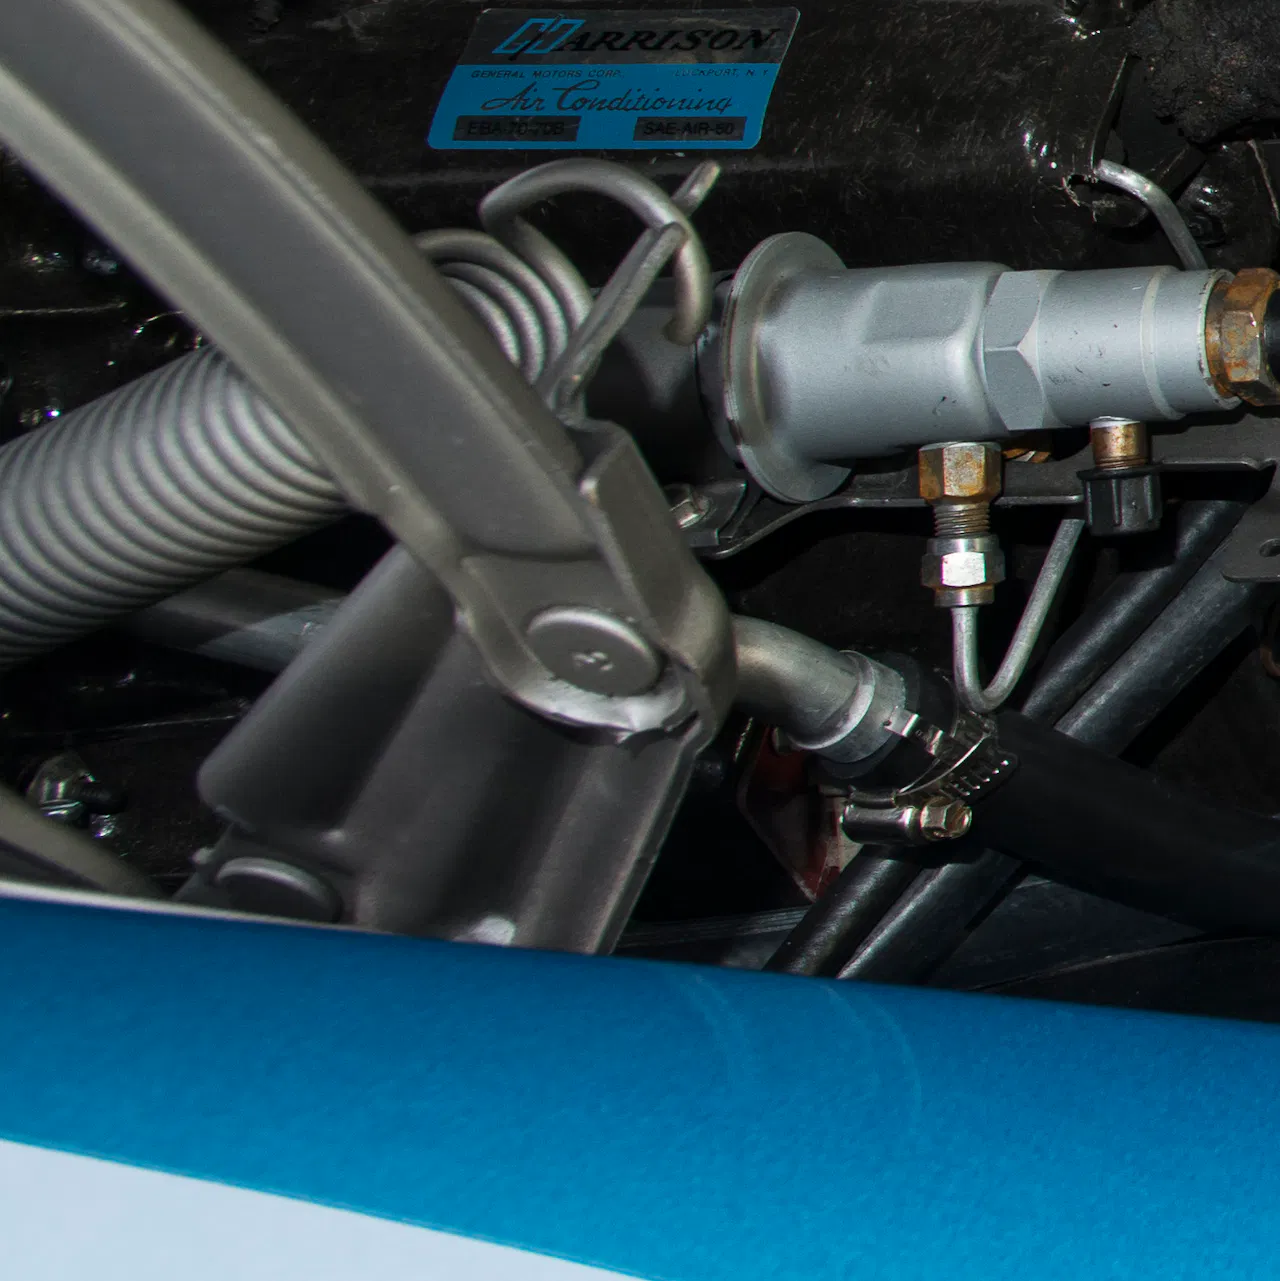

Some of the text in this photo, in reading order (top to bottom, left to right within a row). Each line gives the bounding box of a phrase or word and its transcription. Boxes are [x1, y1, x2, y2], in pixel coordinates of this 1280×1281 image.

[491, 13, 781, 61] HARRISON
[470, 69, 525, 79] GENERAL
[533, 69, 583, 79] MOTORS
[480, 79, 733, 114] Air Conditioning
